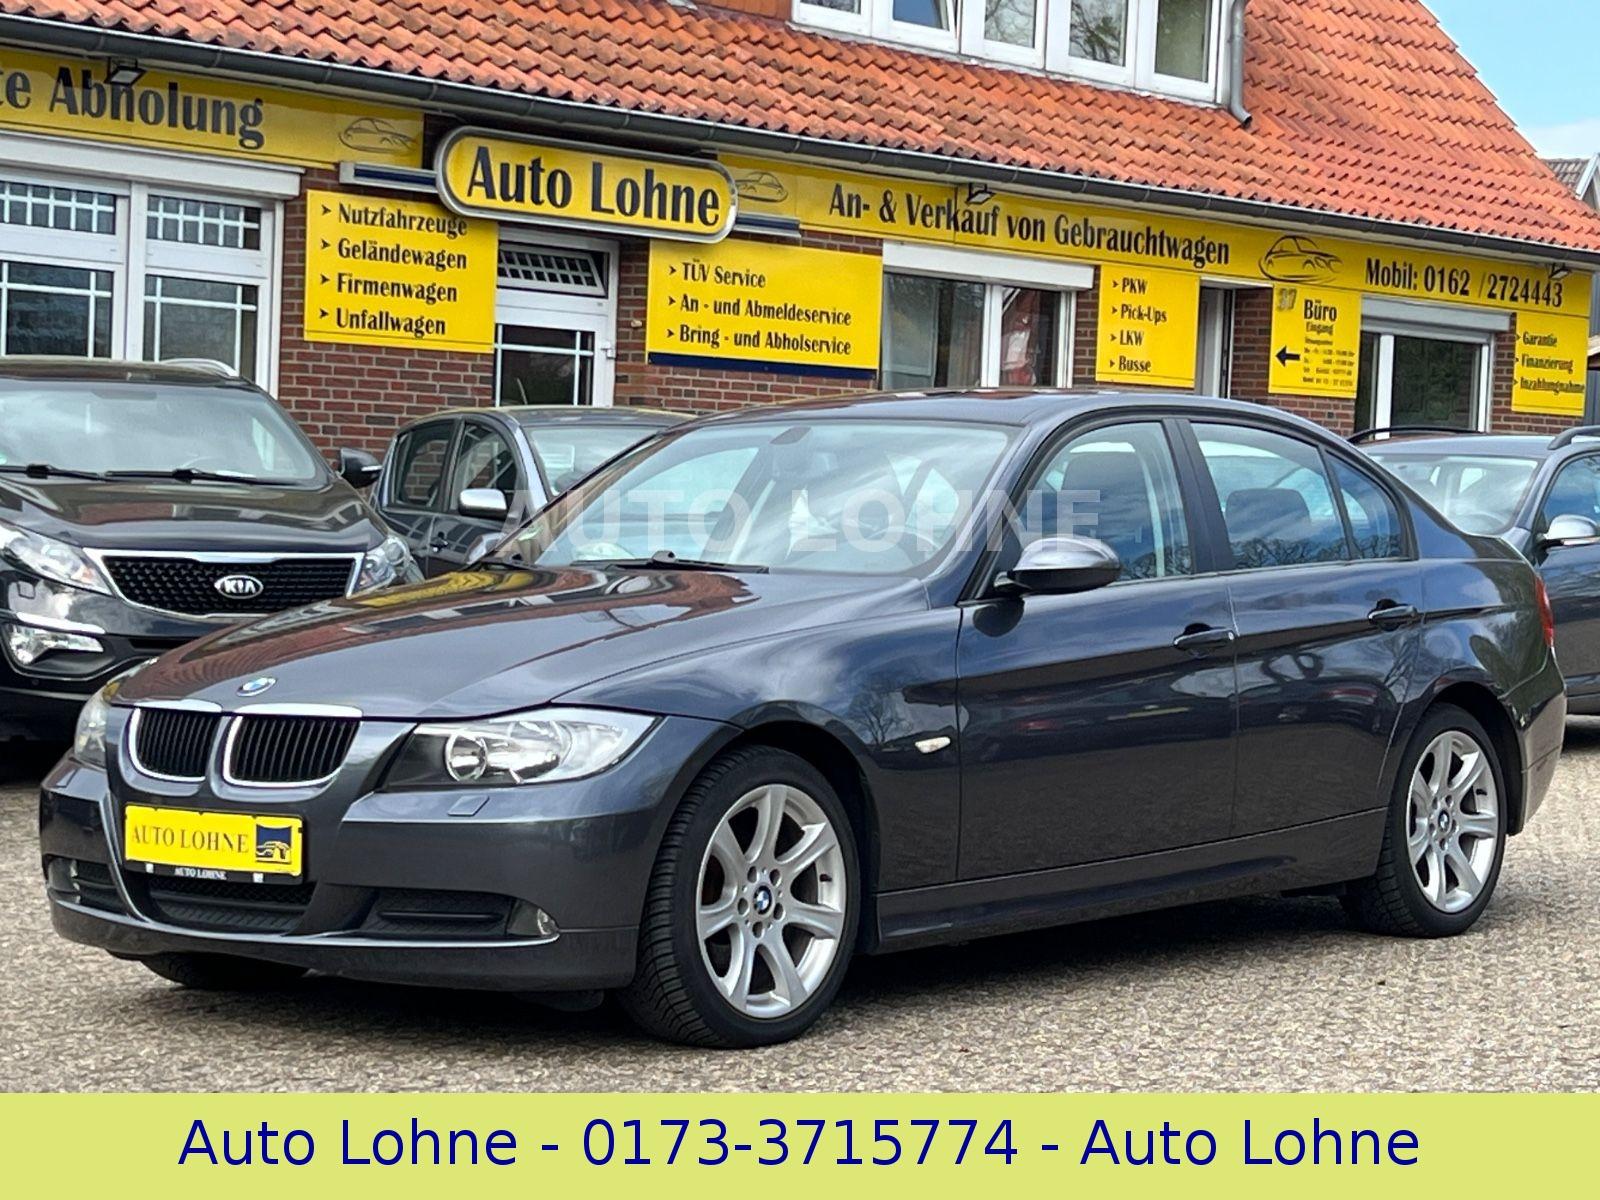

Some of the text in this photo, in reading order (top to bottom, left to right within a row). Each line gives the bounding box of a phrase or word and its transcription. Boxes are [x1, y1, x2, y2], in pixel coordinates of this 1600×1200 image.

[49, 66, 265, 150] Abholung
[467, 146, 719, 226] Auto Lohne
[338, 203, 468, 236] Nutzfahrzeuge
[829, 183, 1230, 269] An- & Verkauf von Gebrauchtwagen
[338, 238, 468, 270] Geländewagen
[682, 258, 766, 288] TÜV Service
[1121, 277, 1149, 295] PKW
[1365, 258, 1418, 291] Mobil:
[1424, 265, 1470, 296] 0162
[337, 273, 458, 304] Firmenwagen
[337, 308, 446, 338] Unfallwagen
[680, 294, 699, 311] An
[713, 299, 741, 315] und
[745, 301, 852, 326] Abmeldeservice
[1120, 303, 1167, 323] Pick-Ups
[1304, 298, 1338, 321] Büro
[680, 324, 720, 349] Bring
[734, 330, 761, 347] und
[765, 332, 852, 355] Abholservice
[1120, 329, 1145, 346] LKW
[1118, 355, 1151, 373] Busse
[225, 580, 256, 593] KIA
[132, 824, 250, 853] AUTO LOHNE
[175, 867, 227, 880] AUTO LOHNE
